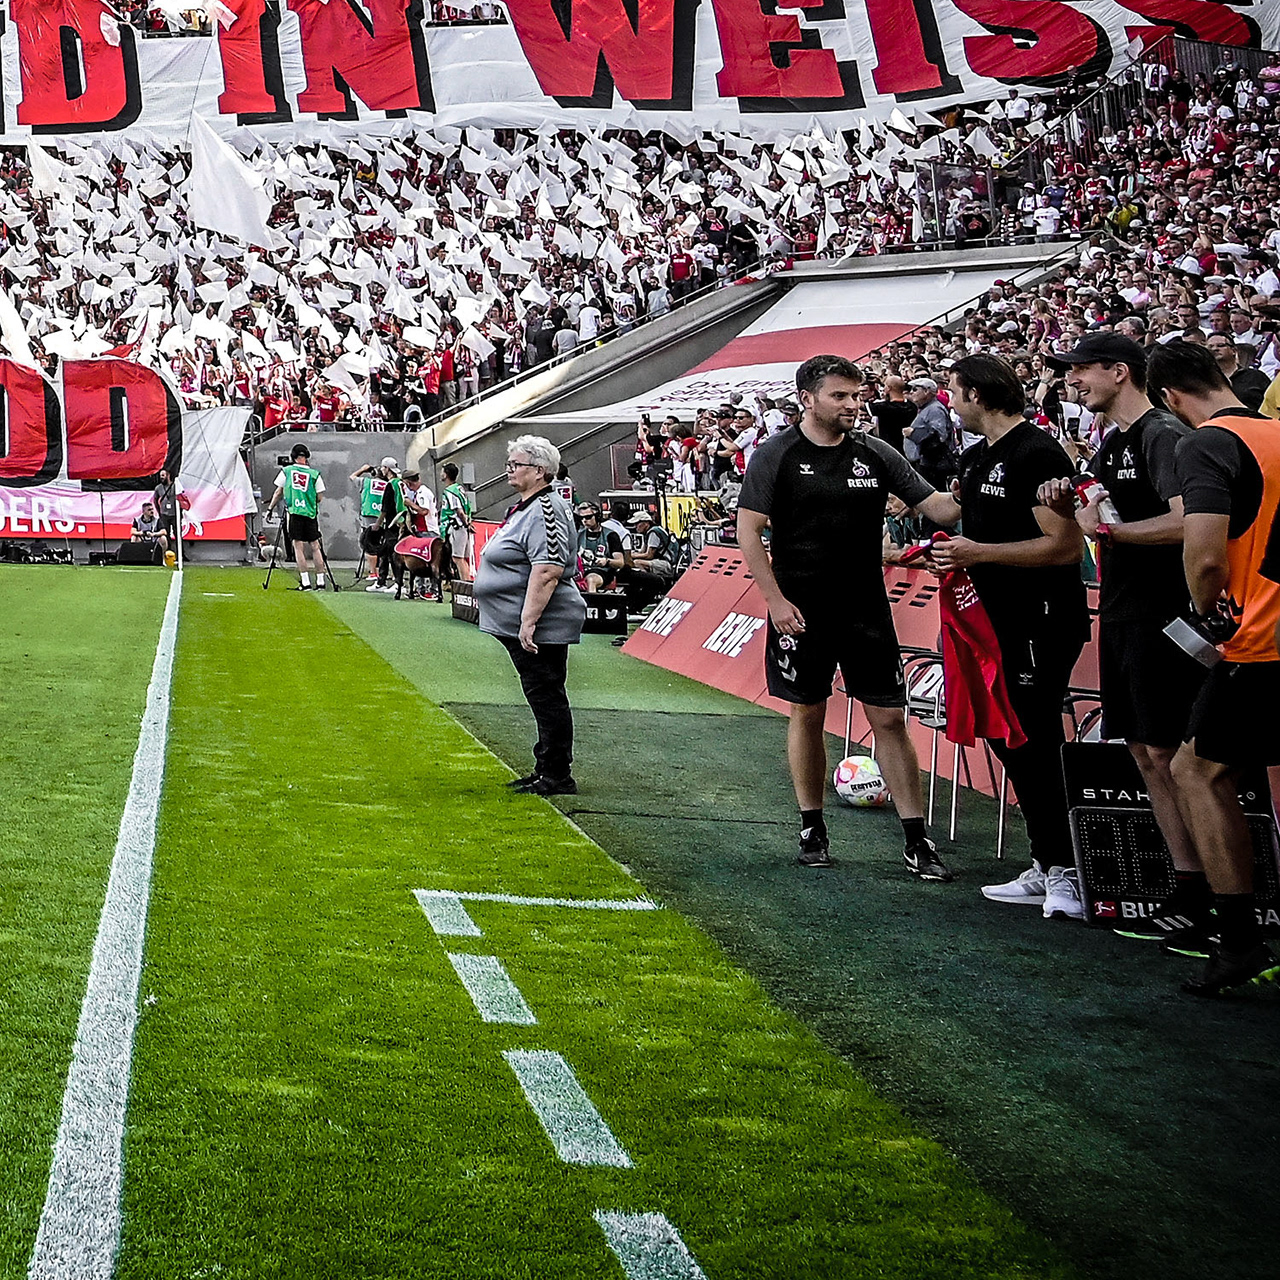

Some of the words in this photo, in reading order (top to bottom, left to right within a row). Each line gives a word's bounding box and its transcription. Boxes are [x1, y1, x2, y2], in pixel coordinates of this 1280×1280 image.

[847, 478, 879, 488] REWE
[981, 483, 1006, 498] REWE
[640, 597, 694, 637] REWE
[702, 611, 767, 659] REWE
